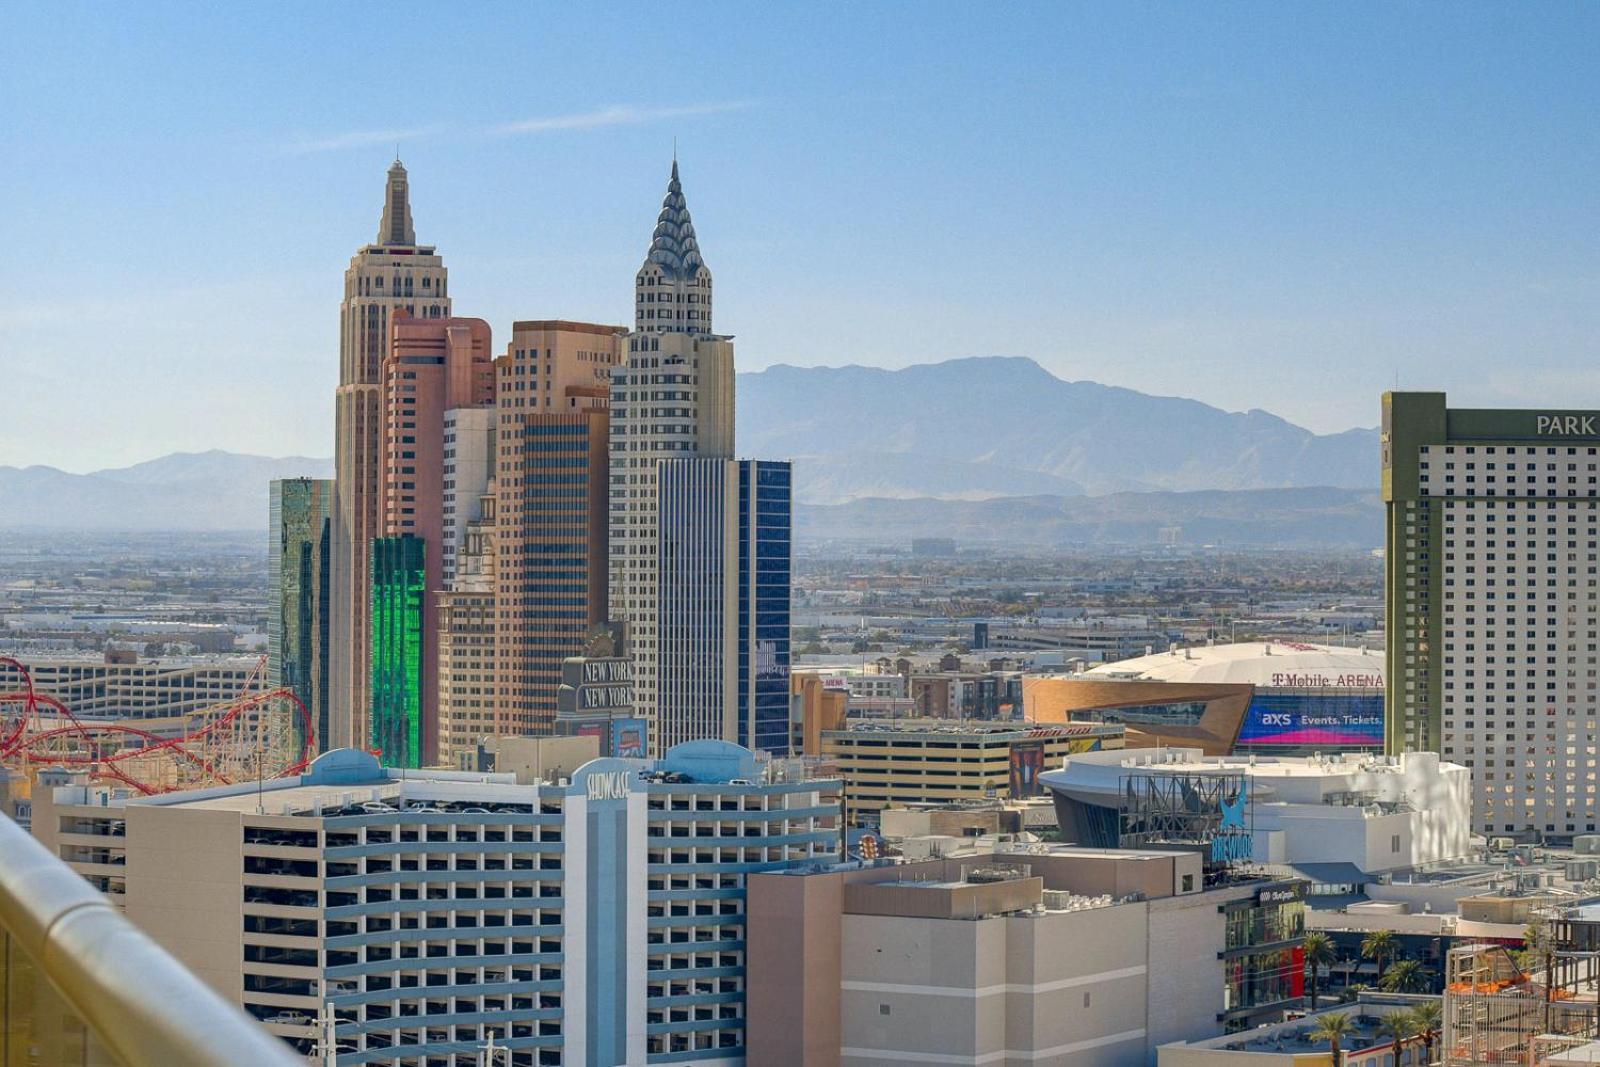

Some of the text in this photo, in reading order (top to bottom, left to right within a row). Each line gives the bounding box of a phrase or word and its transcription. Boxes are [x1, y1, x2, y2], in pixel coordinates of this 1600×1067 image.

[1537, 415, 1596, 435] PARK
[584, 661, 633, 682] NEW YORK
[1336, 674, 1384, 687] ARENA
[584, 687, 633, 708] NEW YORK
[587, 771, 631, 800] SHOWCASE
